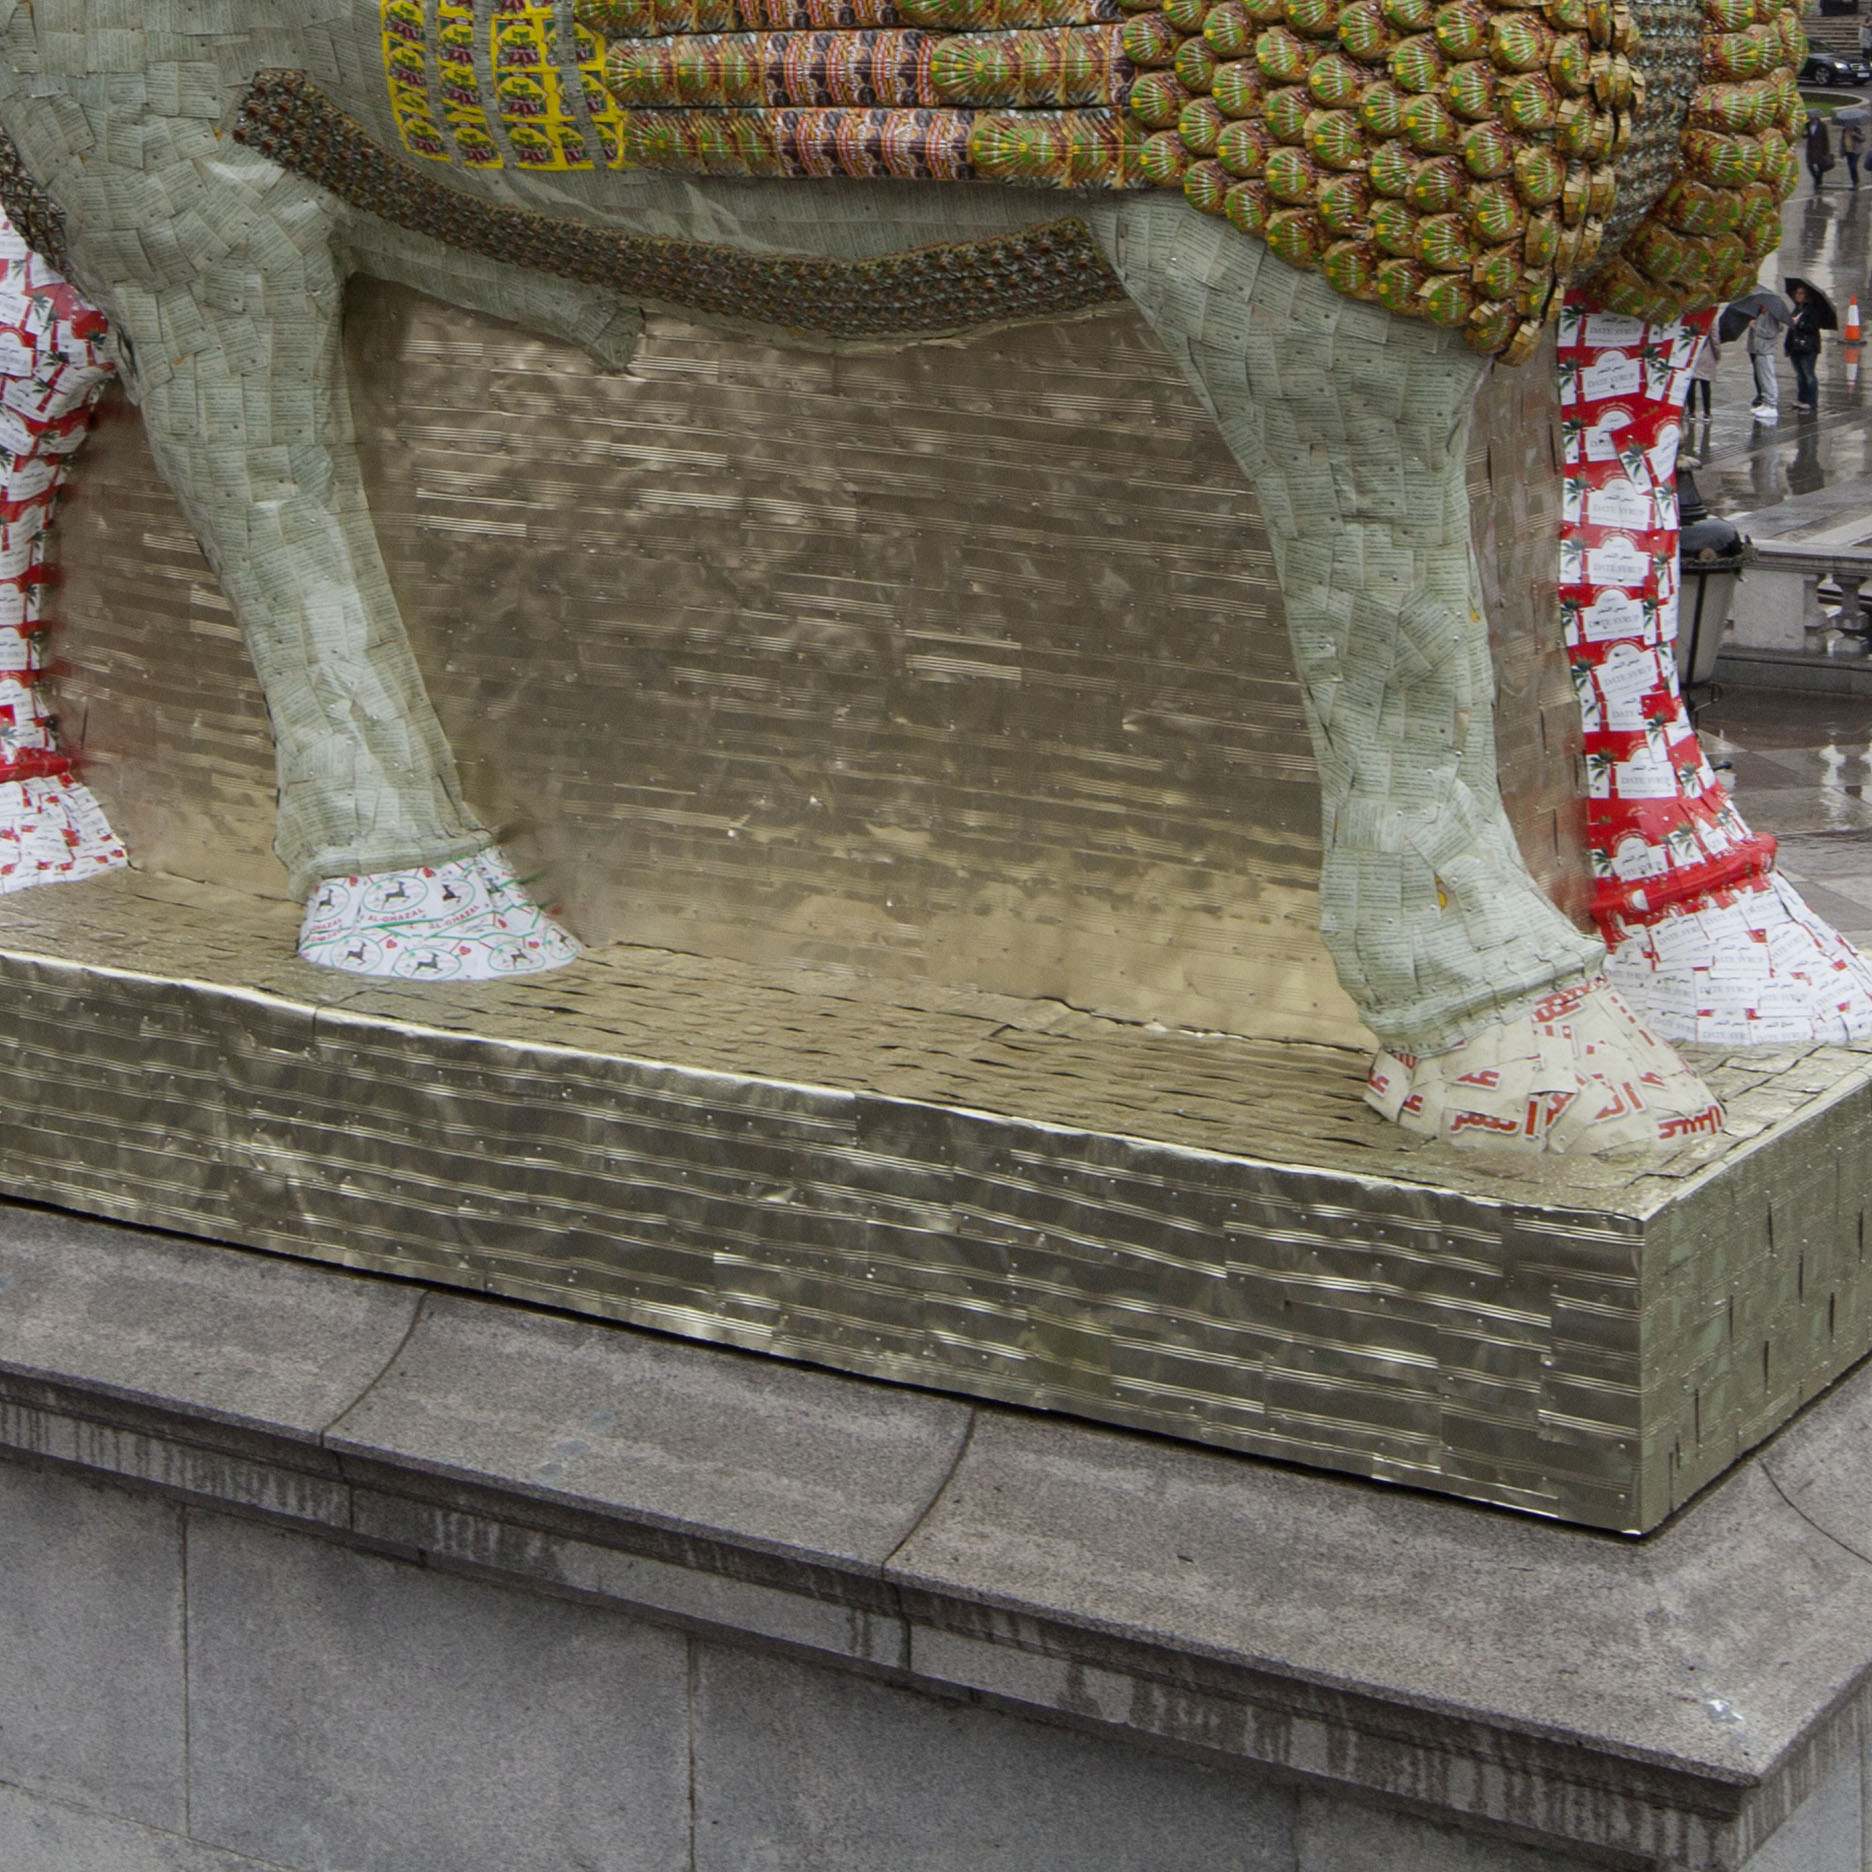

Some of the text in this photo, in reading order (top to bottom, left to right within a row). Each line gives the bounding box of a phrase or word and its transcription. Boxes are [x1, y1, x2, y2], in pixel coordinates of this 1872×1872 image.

[1604, 673, 1629, 687] DATE
[1621, 776, 1644, 785] DATE
[368, 908, 425, 923] AL-GHAZAL
[429, 905, 481, 930] AL-GHAZAL
